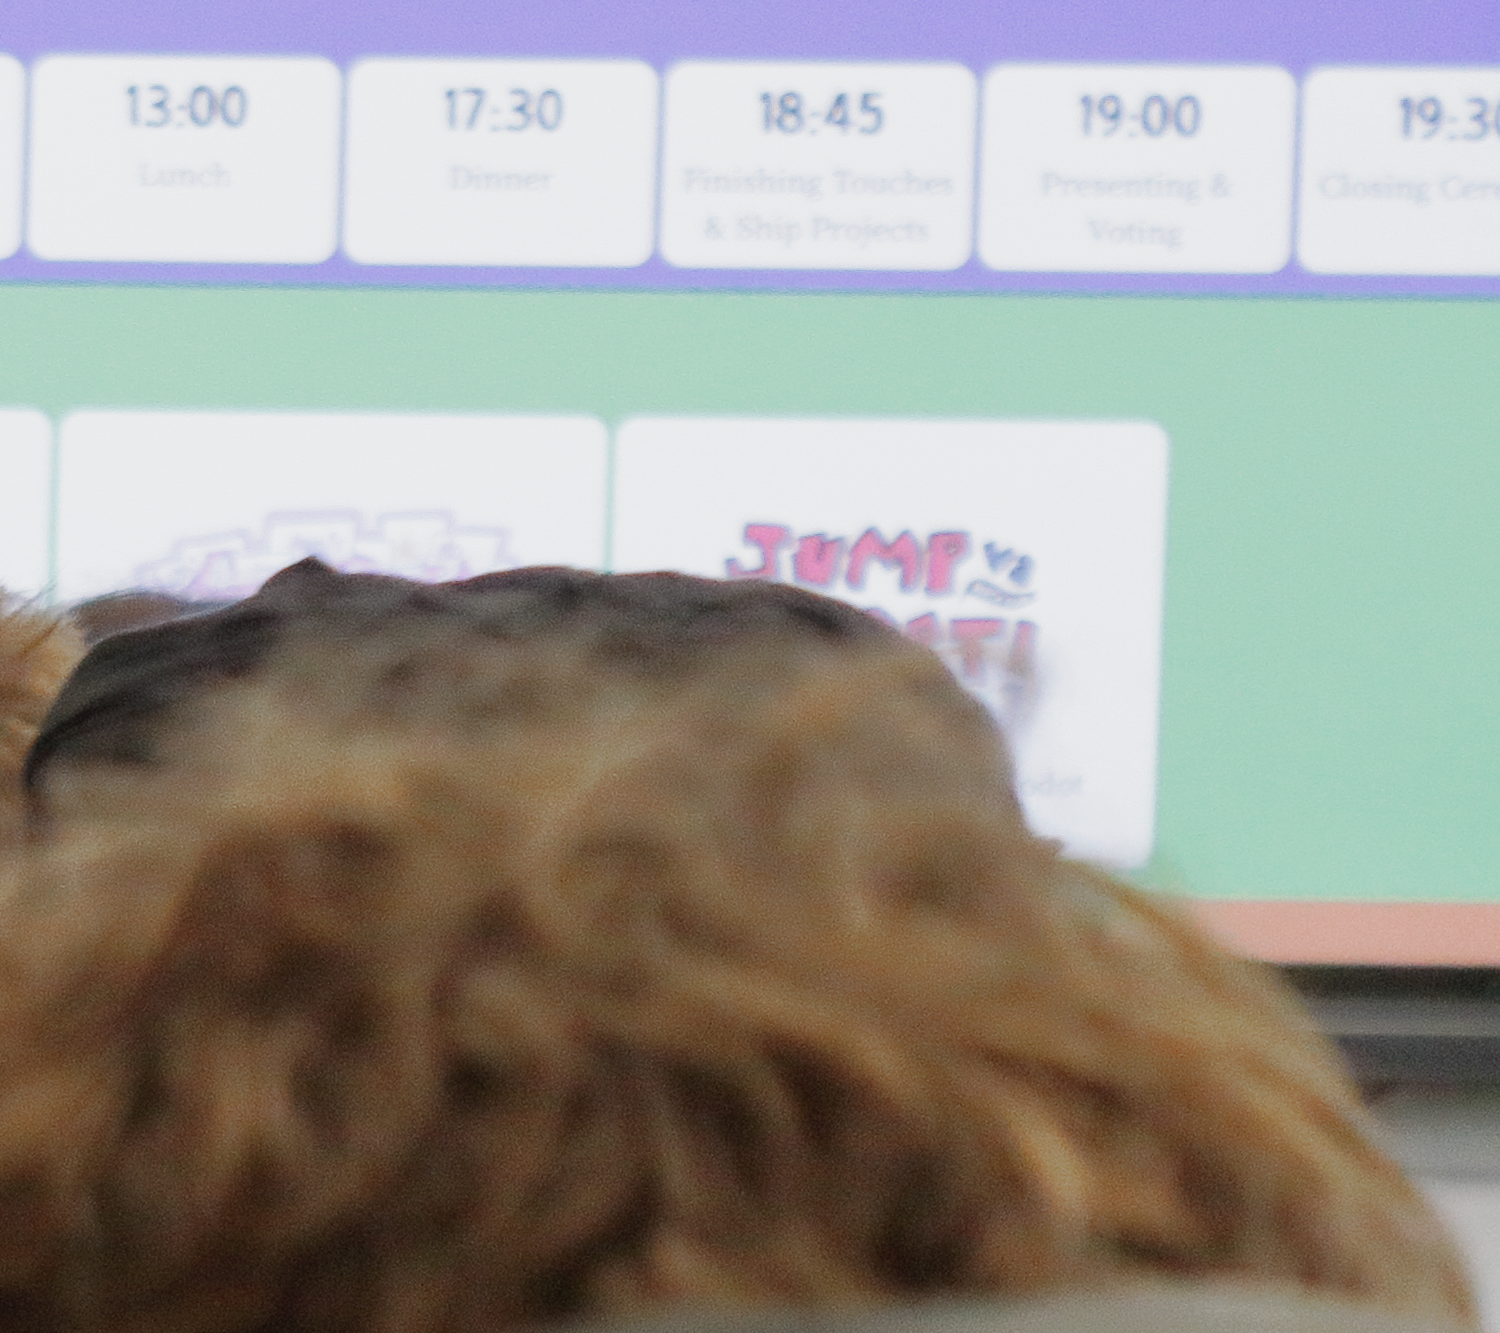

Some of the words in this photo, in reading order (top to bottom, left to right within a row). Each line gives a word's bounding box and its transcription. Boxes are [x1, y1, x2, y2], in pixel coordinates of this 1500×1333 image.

[126, 84, 250, 130] 13:00
[444, 87, 565, 133] 17:30
[759, 90, 887, 137] 18:45
[1079, 93, 1204, 140] 19:00
[1398, 95, 1500, 143] 19:3
[137, 161, 233, 190] Lunch
[448, 163, 555, 193] Dinner
[683, 166, 825, 203] Finishing
[832, 168, 957, 198] Touches
[1040, 169, 1203, 207] Presenting
[1208, 171, 1235, 200] &
[1317, 171, 1434, 210] Closing
[703, 215, 727, 243] &
[736, 214, 804, 251] Ship
[810, 215, 931, 251] Projects
[1086, 217, 1186, 254] Voting
